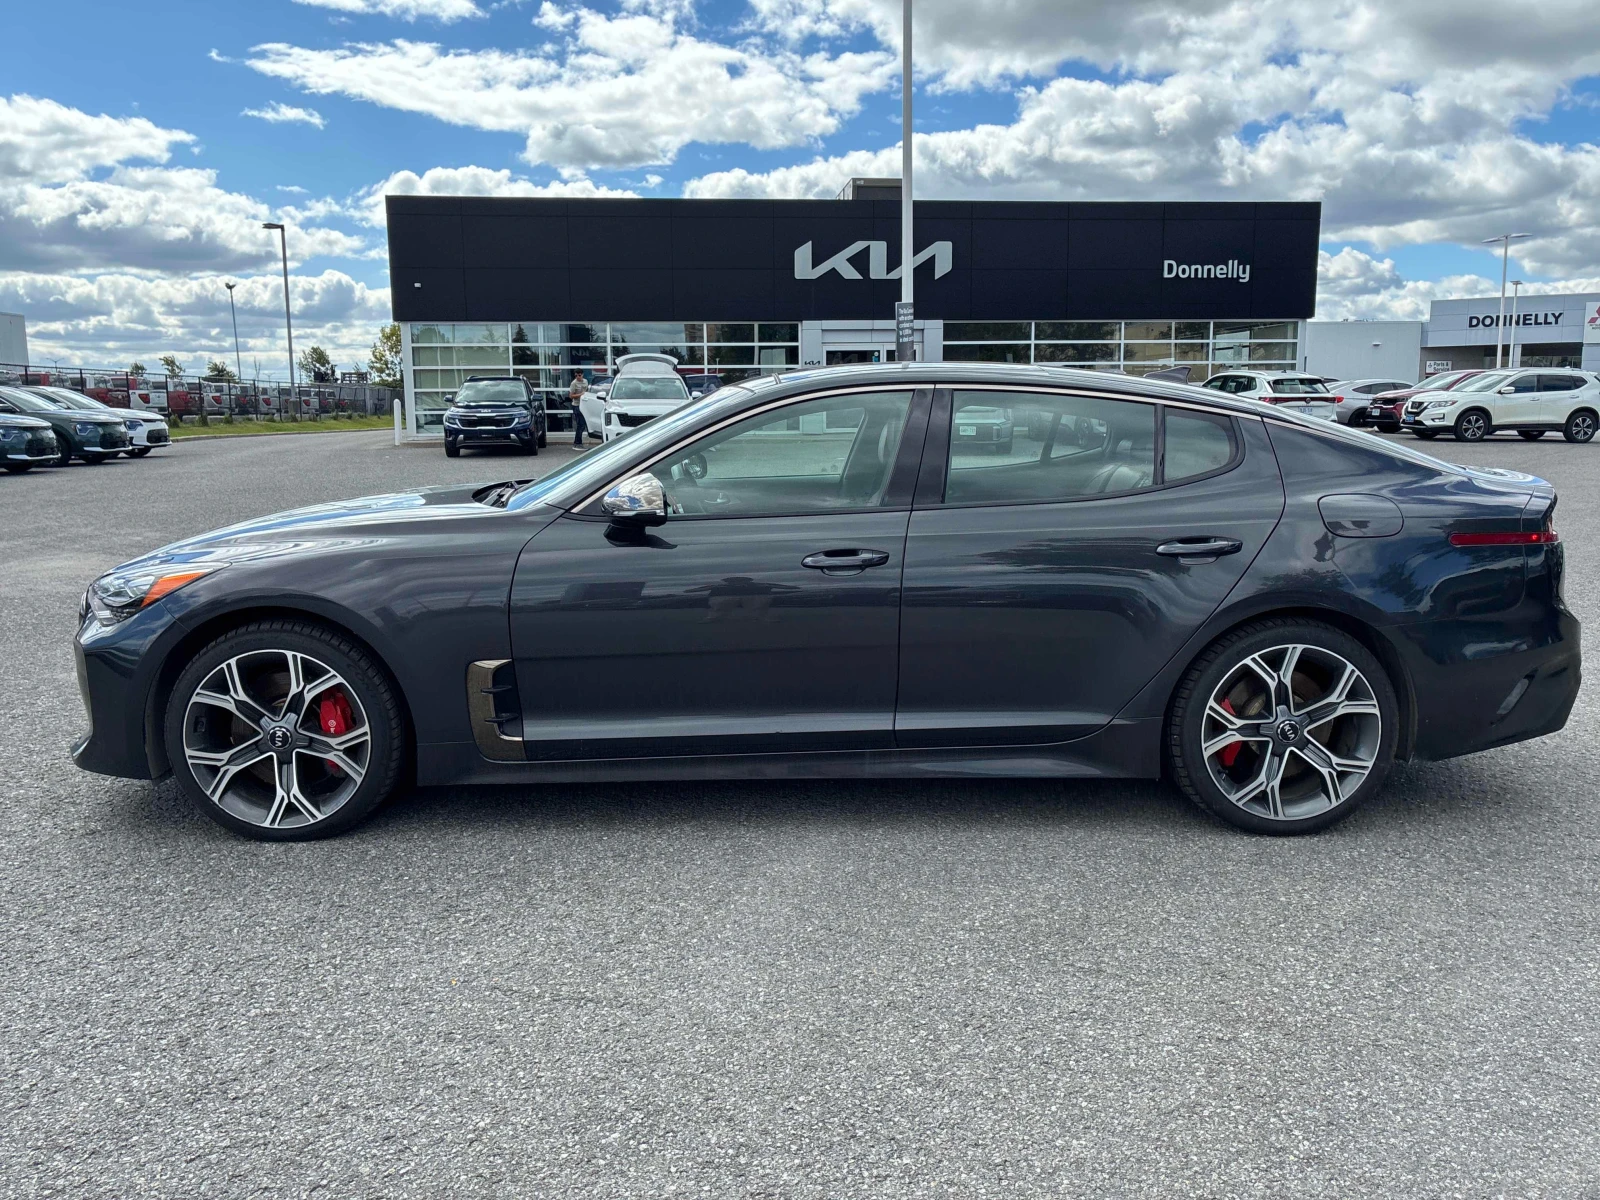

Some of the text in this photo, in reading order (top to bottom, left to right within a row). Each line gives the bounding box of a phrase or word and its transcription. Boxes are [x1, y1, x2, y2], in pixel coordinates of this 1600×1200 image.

[794, 240, 953, 280] KIA
[1163, 259, 1250, 283] Donnelly
[1468, 312, 1564, 328] DONNELLY
[275, 730, 283, 747] KIA
[1283, 724, 1295, 741] KIA
